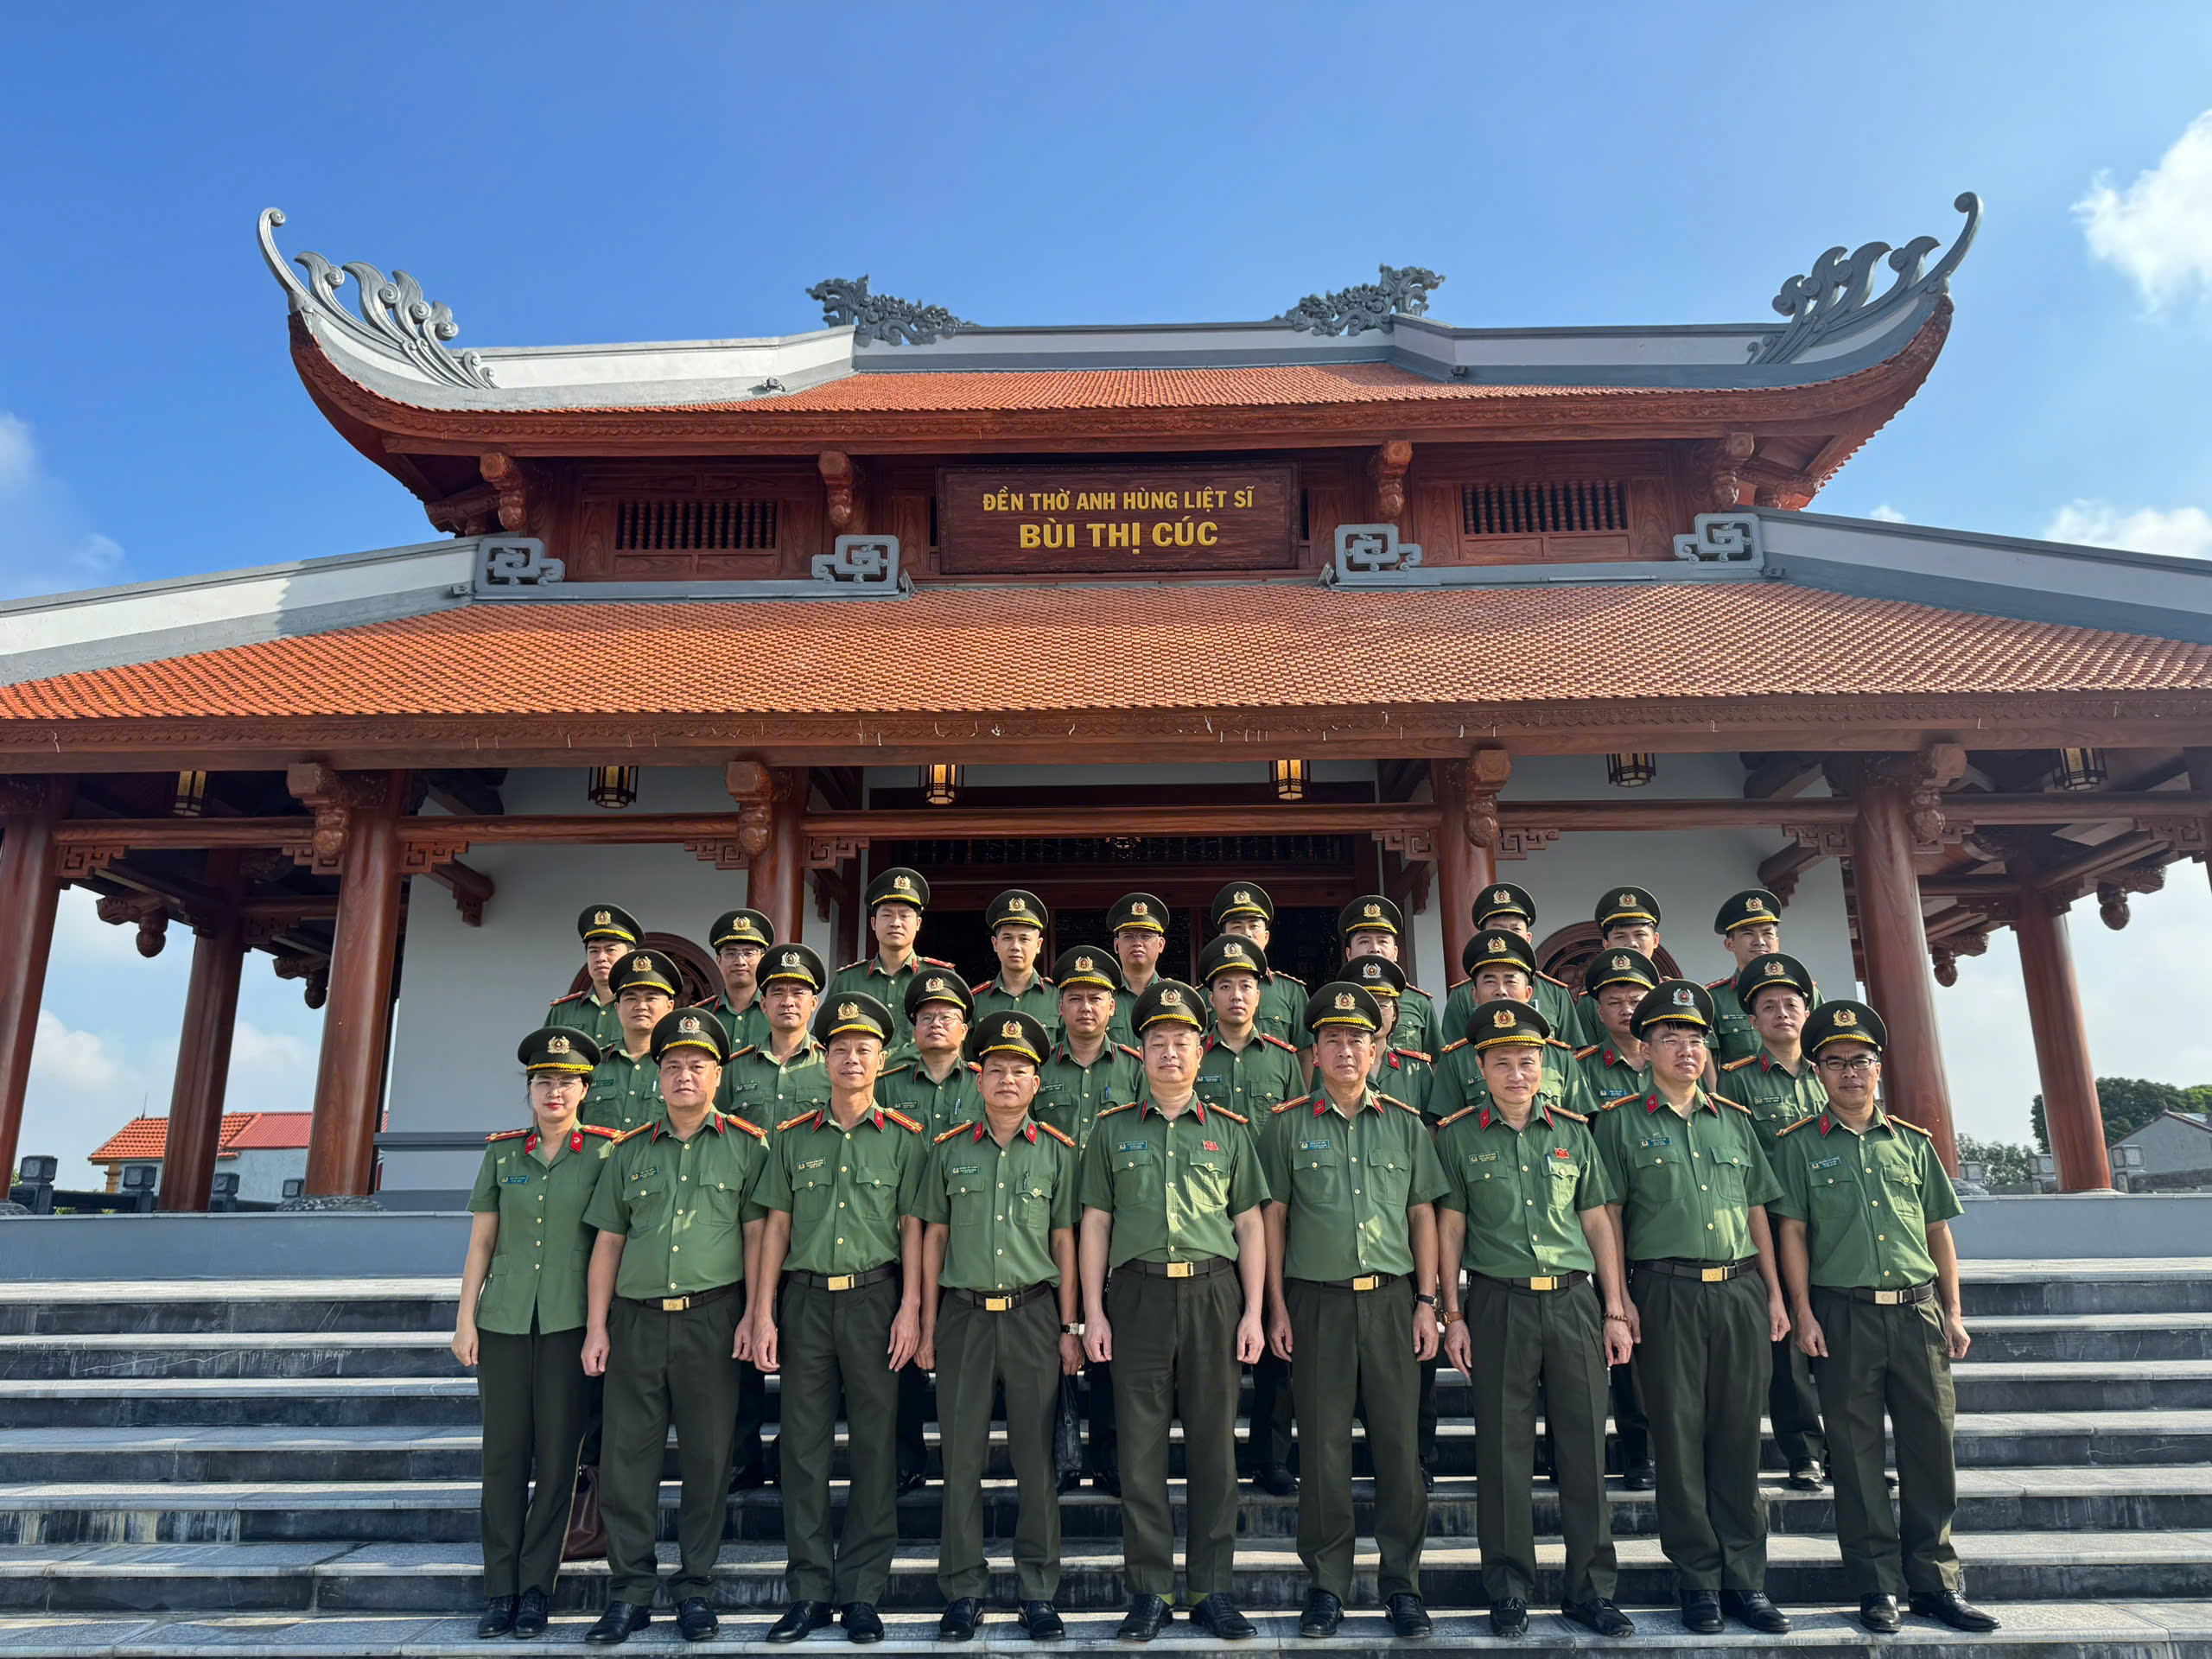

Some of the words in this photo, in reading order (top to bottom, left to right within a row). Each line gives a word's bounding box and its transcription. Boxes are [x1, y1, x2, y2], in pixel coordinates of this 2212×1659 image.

[982, 486, 1024, 512] ĐỀN
[1029, 487, 1071, 512] THỜ
[1076, 492, 1116, 511] ANH
[1123, 487, 1178, 510] HÙNG
[1184, 486, 1227, 512] LIỆT
[1233, 485, 1255, 508] SĨ
[1020, 518, 1075, 549] BÙI
[1086, 522, 1141, 555] THỊ
[1152, 515, 1217, 547] CÚC
